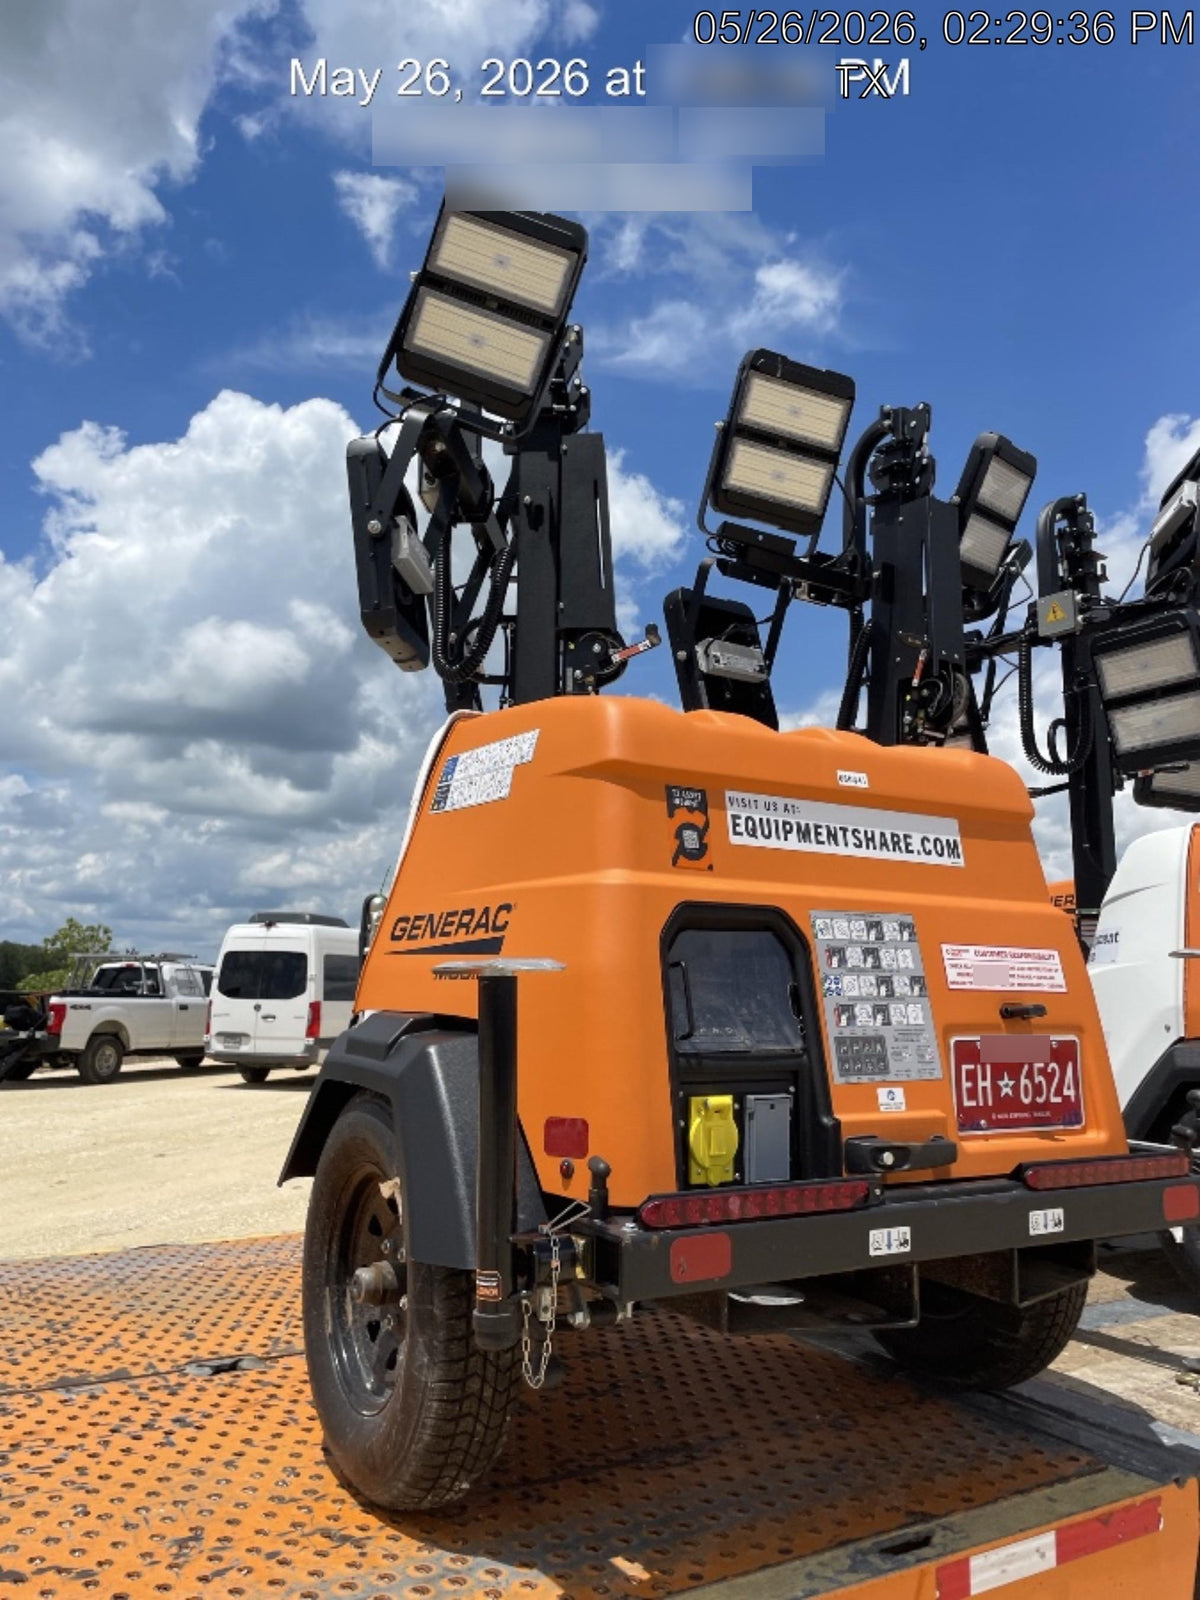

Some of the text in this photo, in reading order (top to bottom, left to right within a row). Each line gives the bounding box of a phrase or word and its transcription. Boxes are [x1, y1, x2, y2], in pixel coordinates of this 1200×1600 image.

[728, 796, 801, 815] VISIT US AT:
[731, 814, 961, 859] EQUIPMENTSHARE.COM
[390, 902, 512, 941] GENERAC
[961, 1061, 1076, 1107] EH 6524
